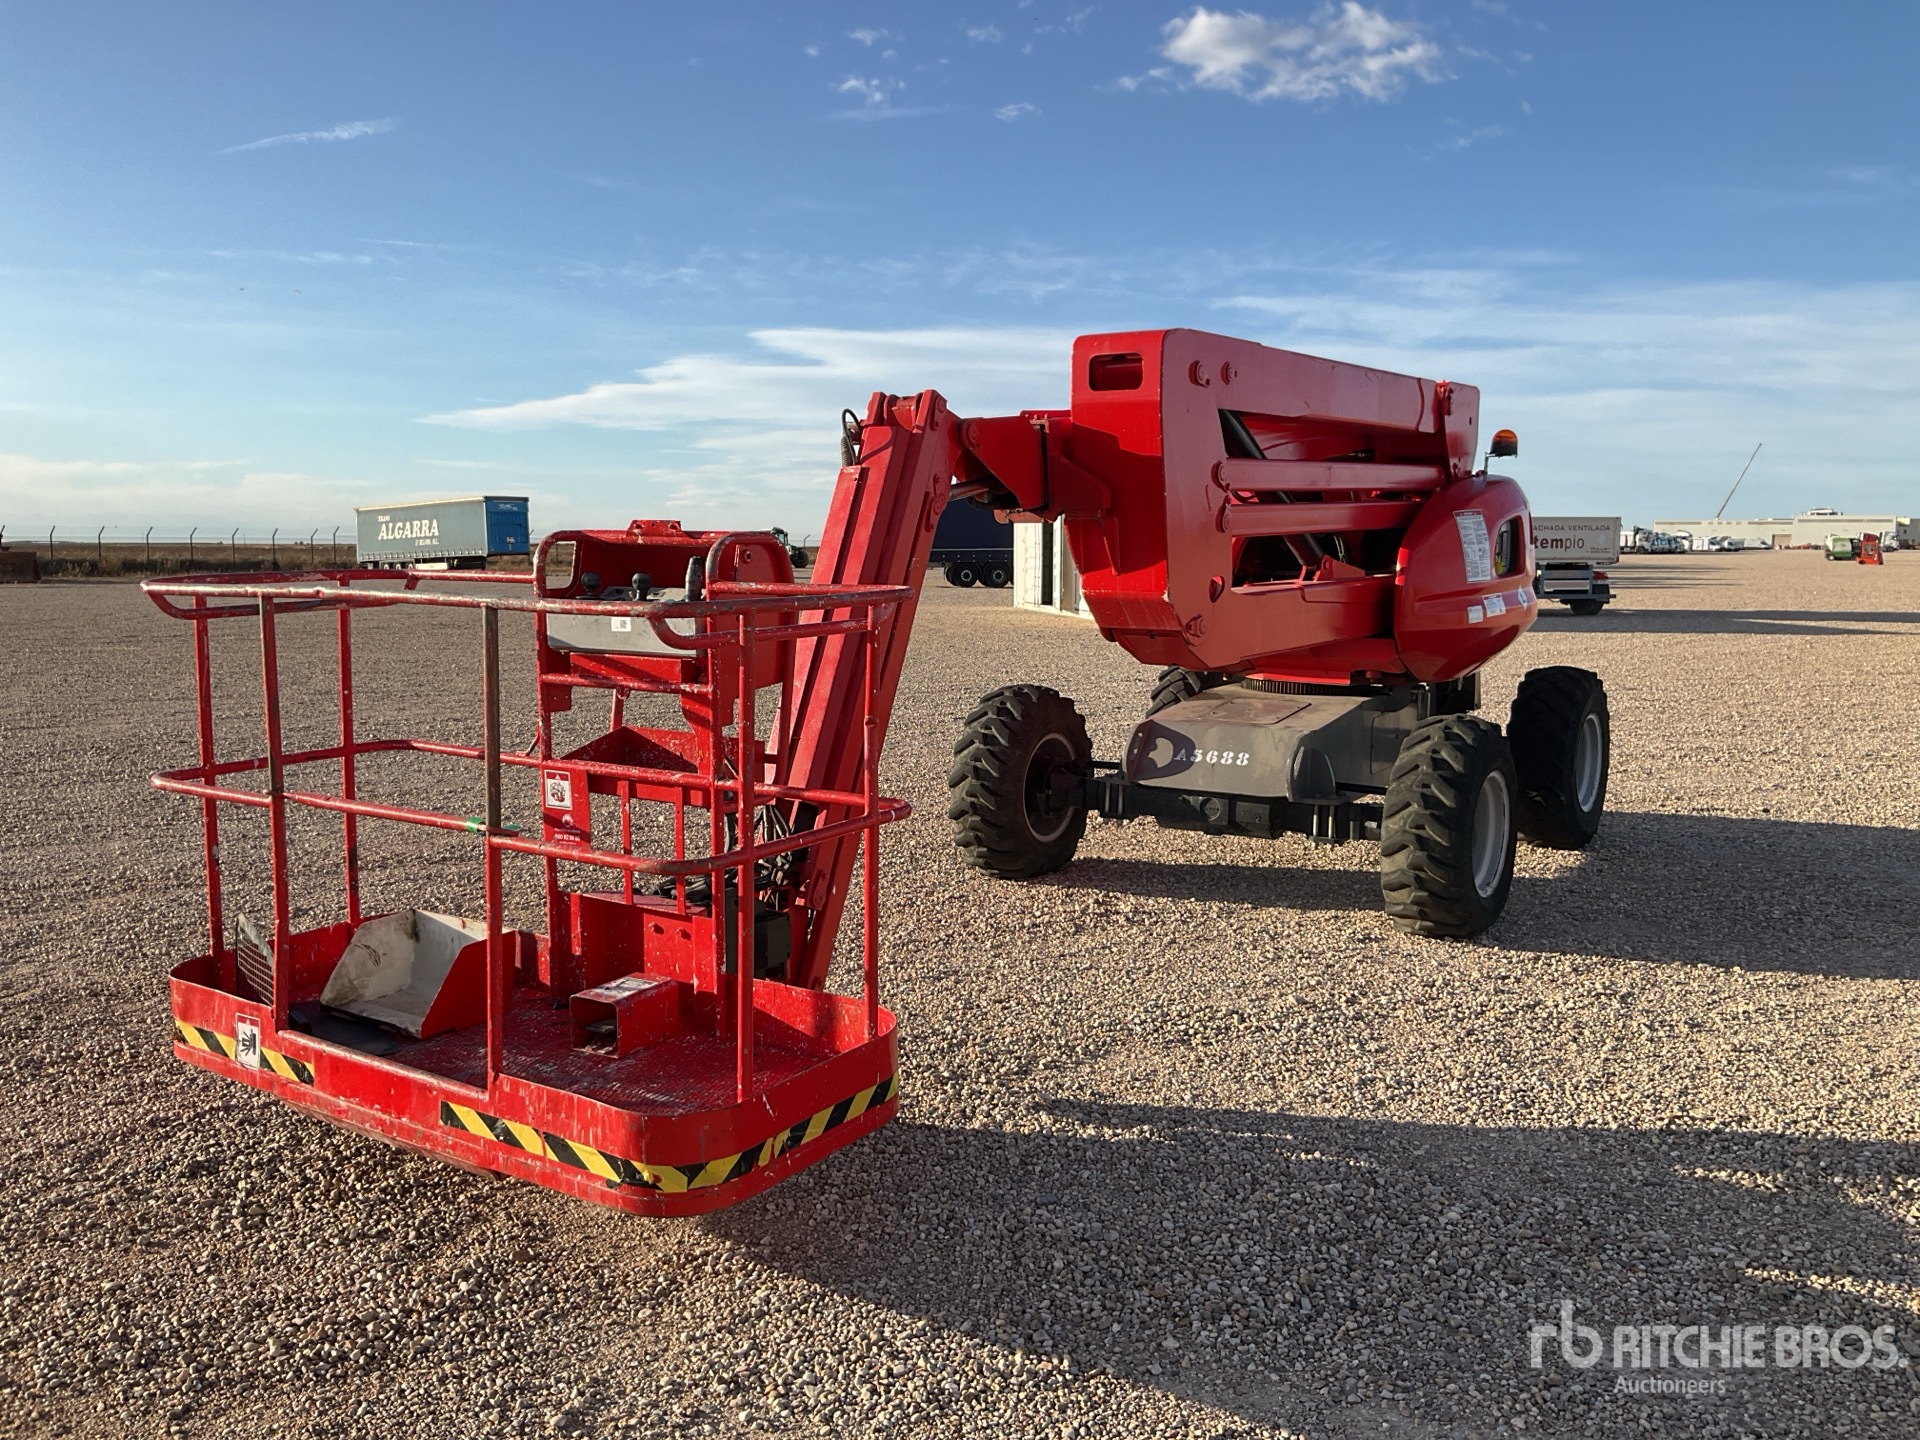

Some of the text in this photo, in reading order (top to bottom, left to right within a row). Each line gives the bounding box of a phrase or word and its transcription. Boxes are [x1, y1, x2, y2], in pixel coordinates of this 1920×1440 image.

[378, 519, 439, 540] ALGARRA
[1534, 535, 1585, 552] tempio
[1173, 748, 1250, 766] A5688
